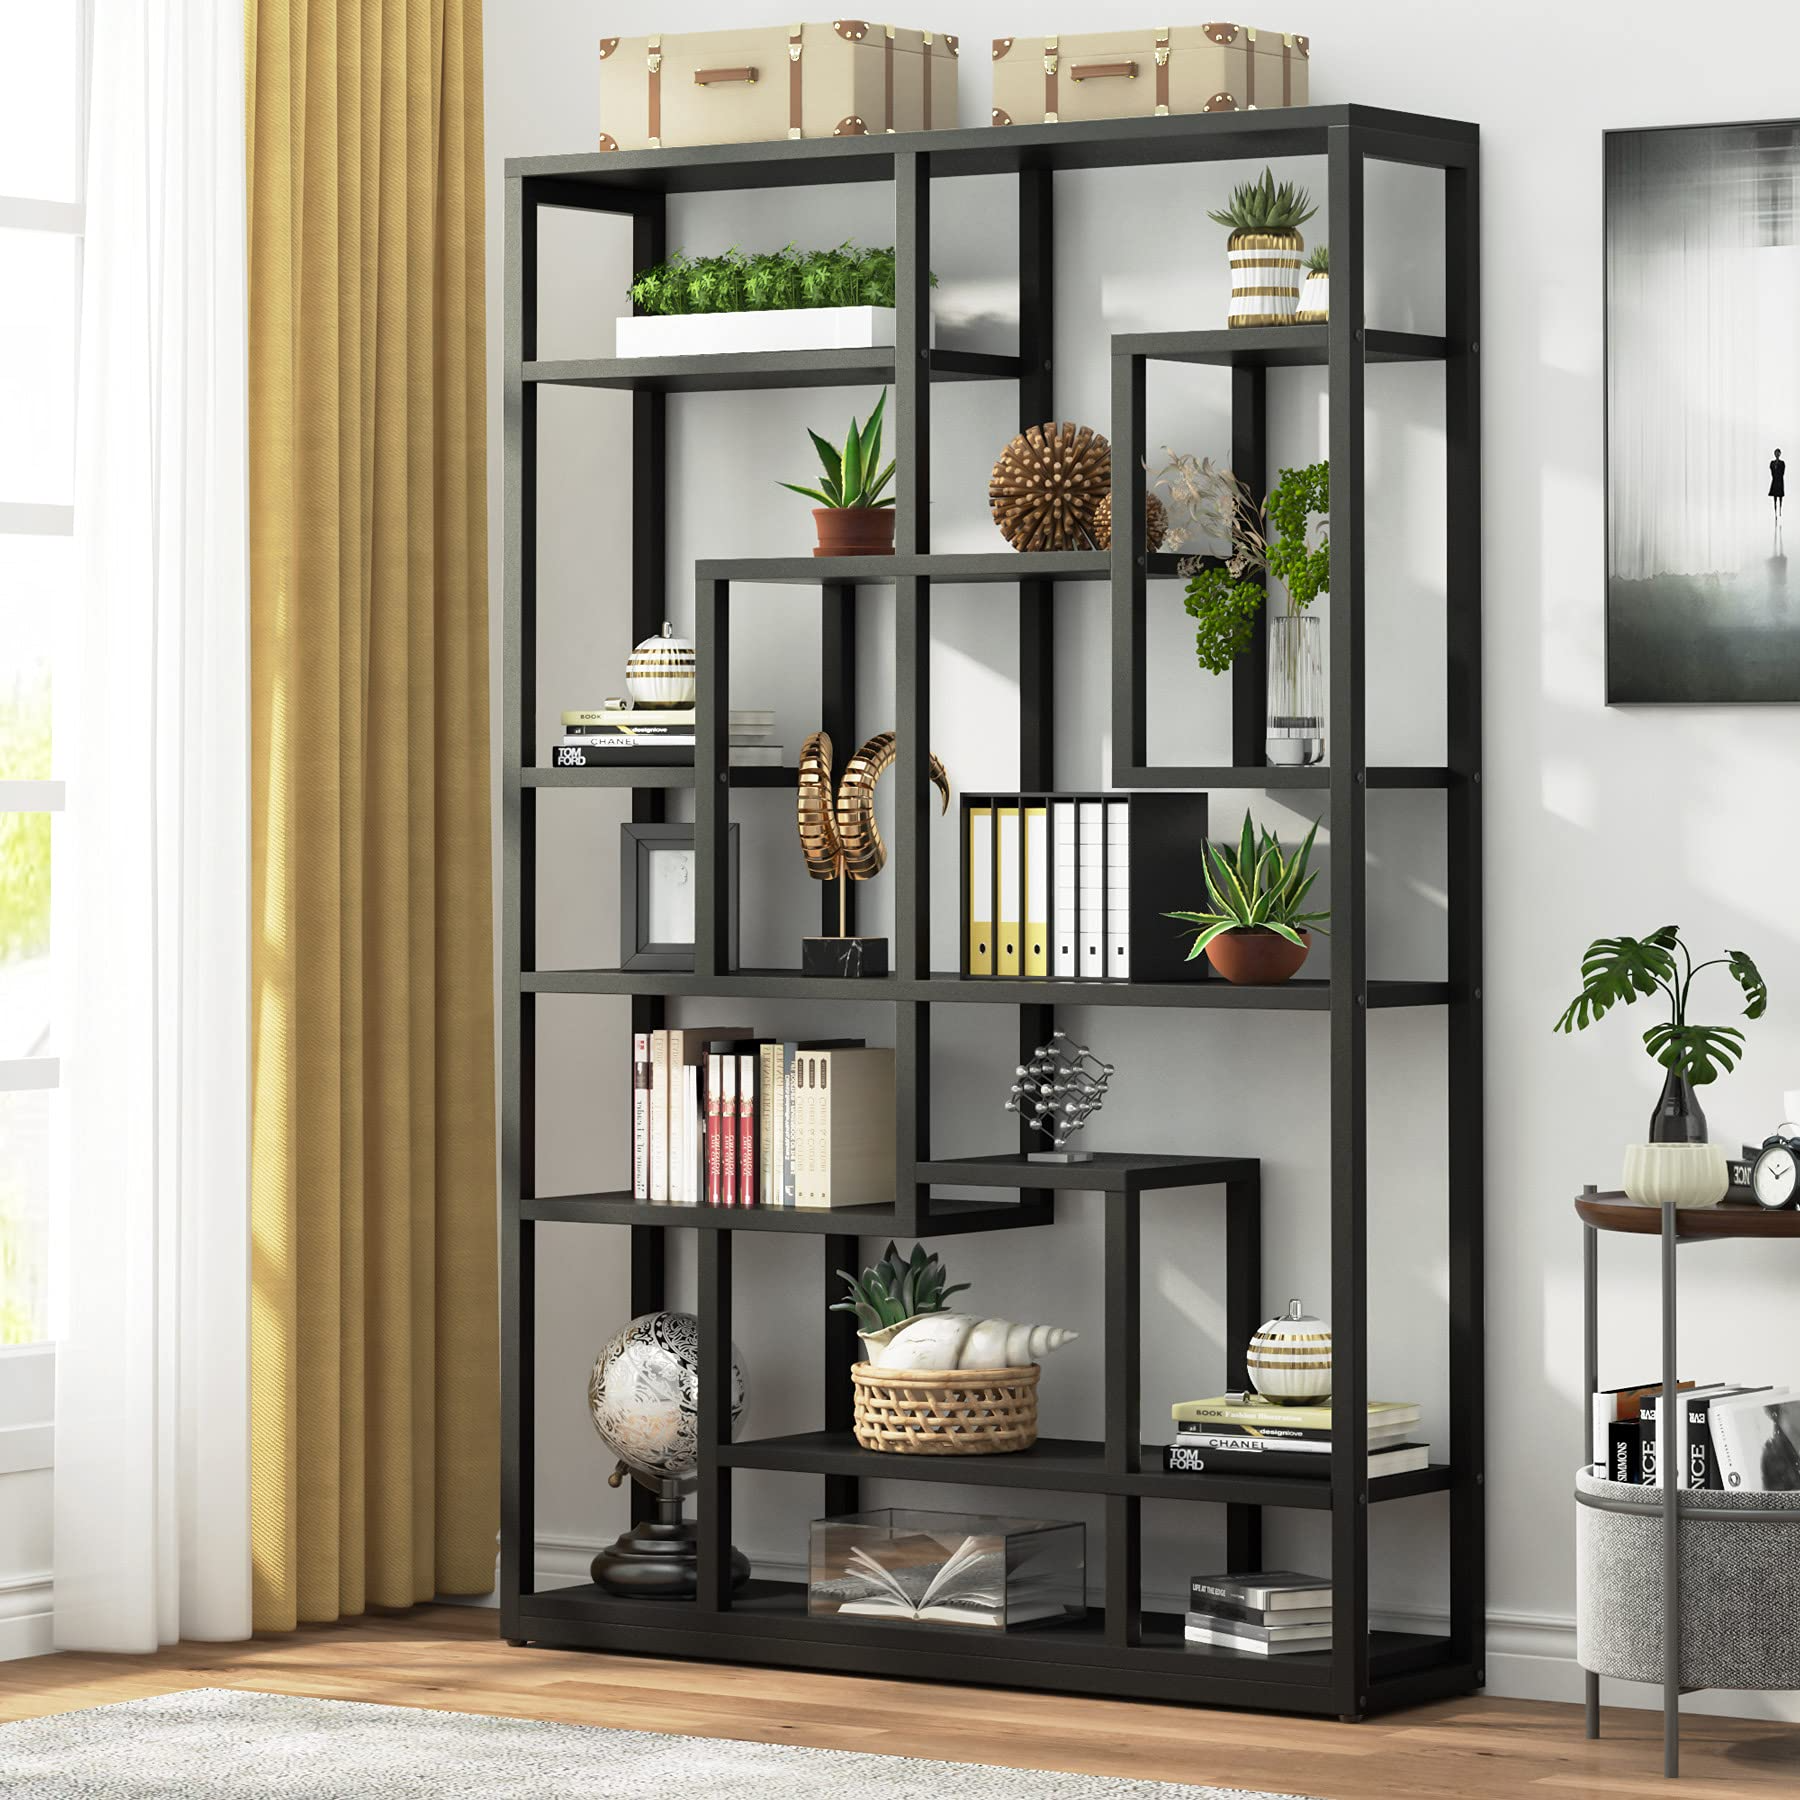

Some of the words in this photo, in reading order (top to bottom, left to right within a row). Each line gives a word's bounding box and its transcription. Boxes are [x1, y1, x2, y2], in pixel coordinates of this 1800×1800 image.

[557, 747, 581, 758] TOM
[557, 756, 586, 766] FORD
[1196, 1409, 1223, 1417] BOOK
[1259, 1428, 1303, 1437] designlove
[1209, 1439, 1268, 1450] CHANEL
[1170, 1448, 1198, 1460] TOM
[1170, 1457, 1204, 1471] FORD
[1616, 1442, 1628, 1482] SIMMONS
